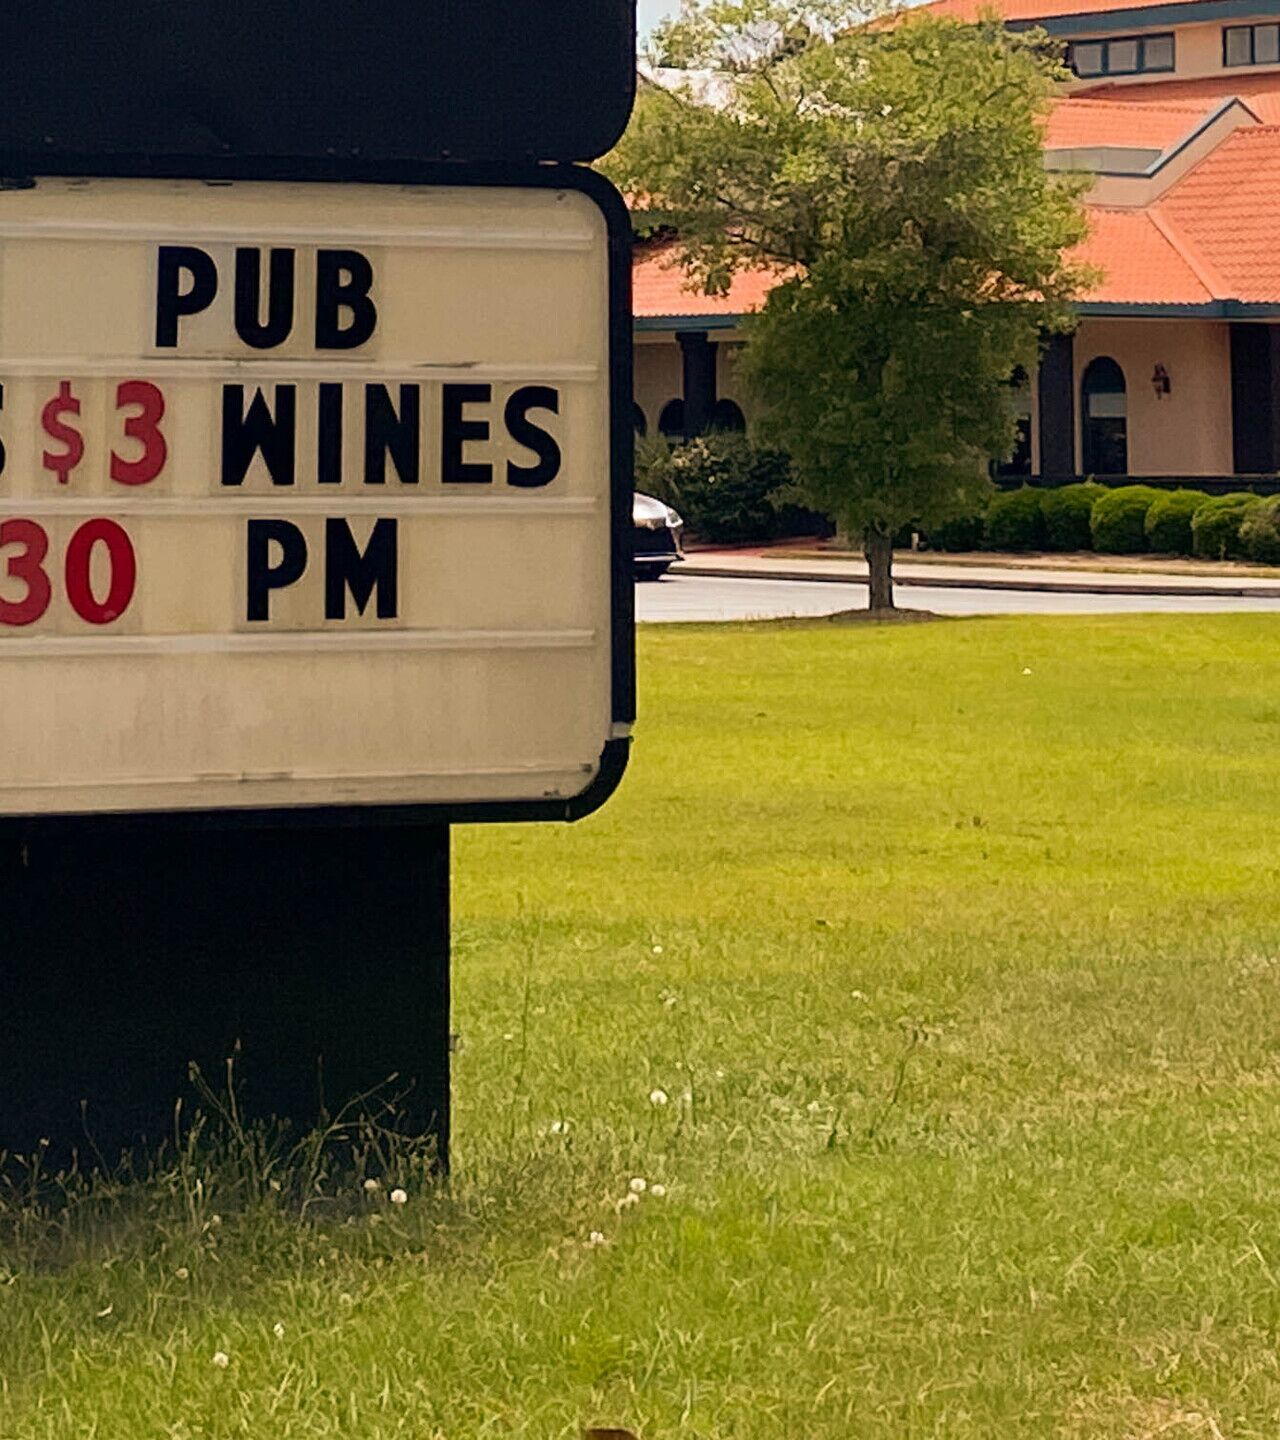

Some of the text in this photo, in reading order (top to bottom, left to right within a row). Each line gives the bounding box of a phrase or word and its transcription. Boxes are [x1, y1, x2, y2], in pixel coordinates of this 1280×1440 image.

[154, 245, 378, 350] PUB
[41, 379, 167, 486] $3
[220, 381, 563, 490] WINES
[246, 516, 399, 623] PM
